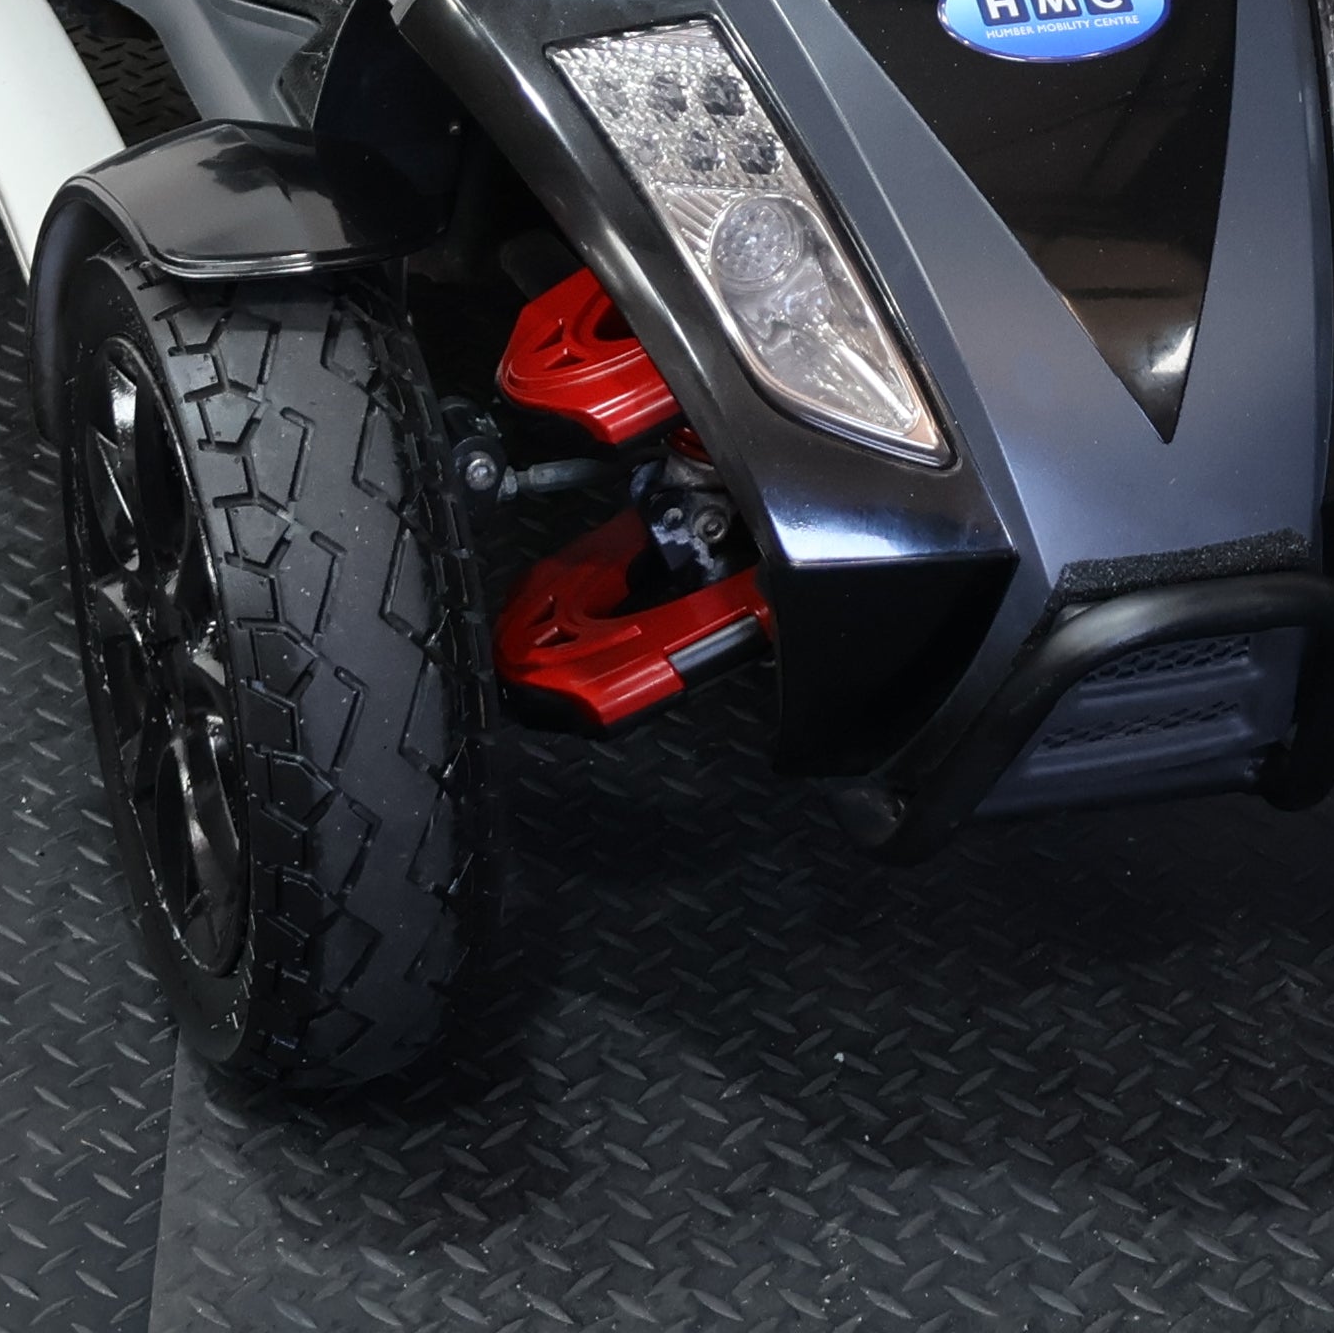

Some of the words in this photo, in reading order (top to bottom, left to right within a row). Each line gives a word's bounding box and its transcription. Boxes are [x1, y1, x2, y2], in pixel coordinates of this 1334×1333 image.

[986, 26, 1034, 39] HUMBER
[1037, 19, 1090, 33] MOBILITY
[1094, 15, 1140, 28] CENTRE
